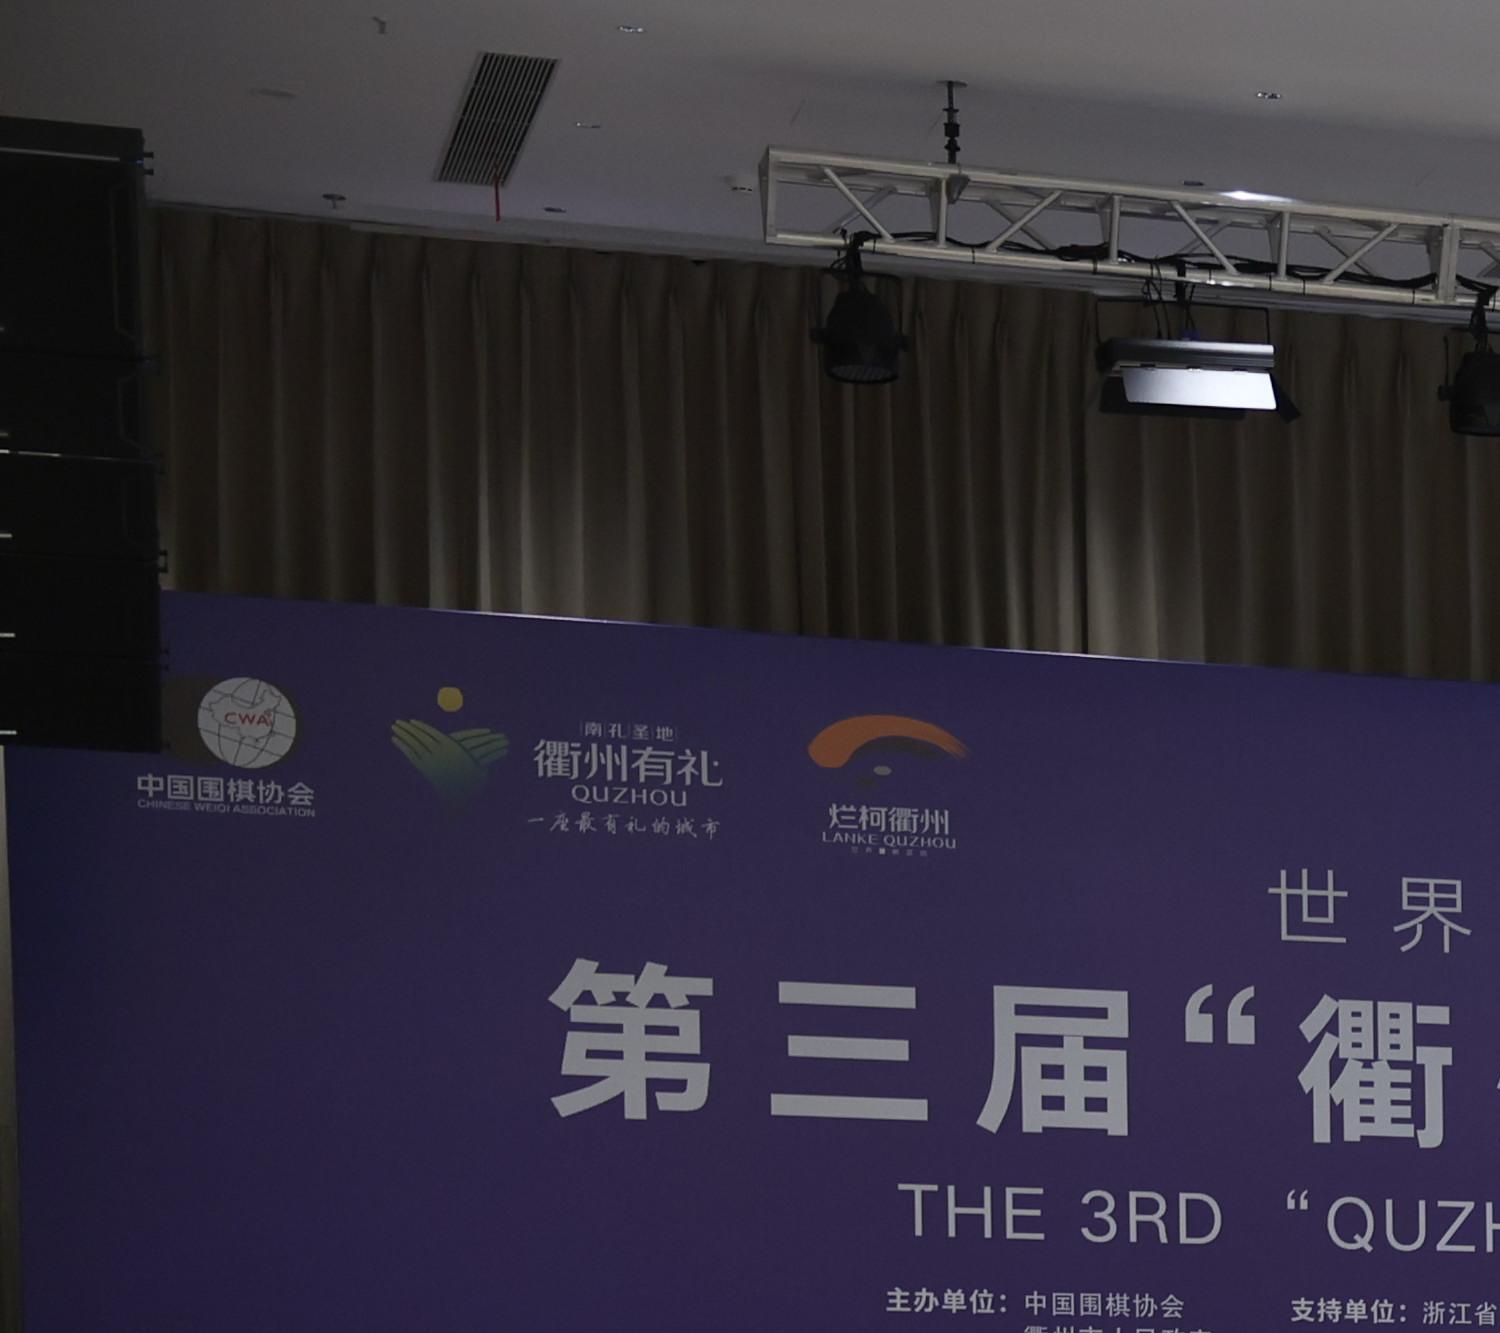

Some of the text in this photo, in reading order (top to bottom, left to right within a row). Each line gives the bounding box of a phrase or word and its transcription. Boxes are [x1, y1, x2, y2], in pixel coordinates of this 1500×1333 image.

[224, 711, 270, 727] CWA
[584, 721, 674, 742] 南孔圣地
[533, 739, 723, 787] 衢州有礼
[137, 773, 315, 806] 中国围棋协会
[571, 784, 687, 807] QUZHOU
[137, 798, 191, 811] CHINESE
[828, 803, 949, 835] 烂柯衢州
[822, 831, 956, 849] LANKE QUZHOU
[897, 1183, 1045, 1240] THE
[1081, 1189, 1222, 1245] 3RD
[1024, 1290, 1184, 1319] 中国围棋协会
